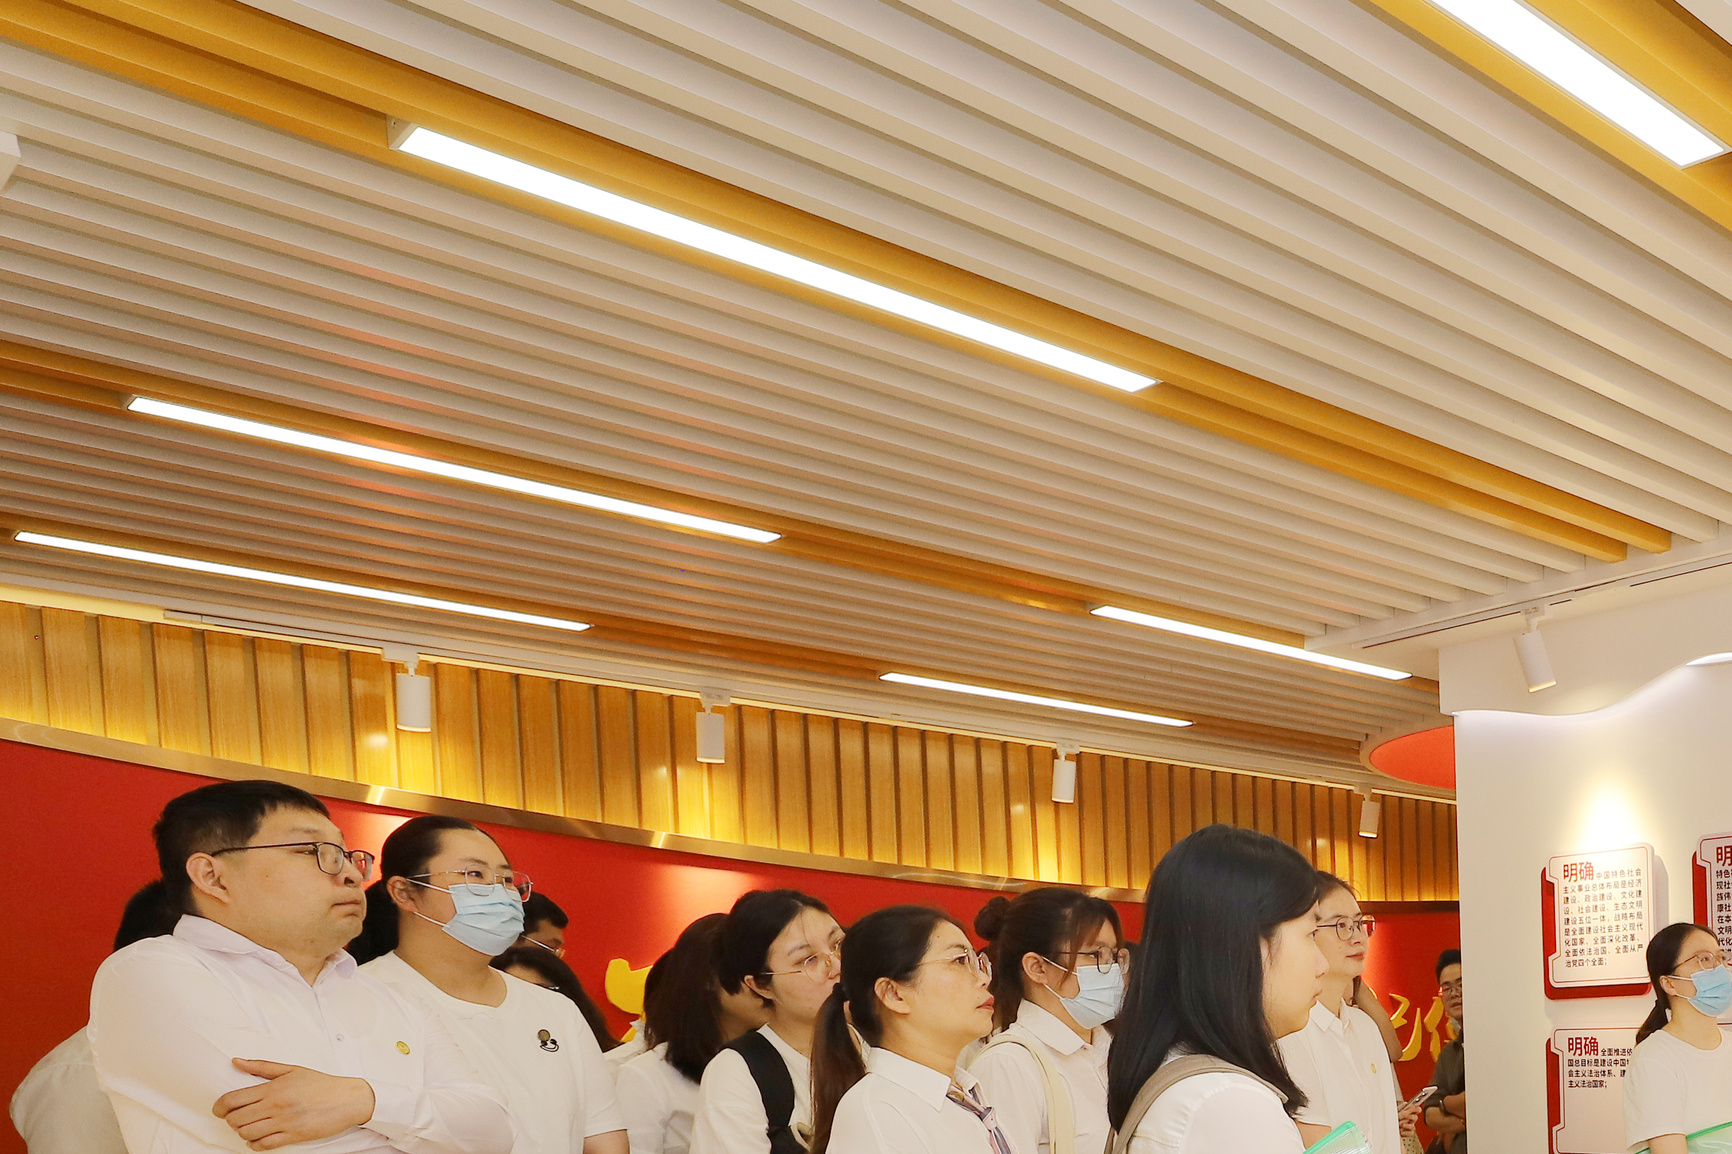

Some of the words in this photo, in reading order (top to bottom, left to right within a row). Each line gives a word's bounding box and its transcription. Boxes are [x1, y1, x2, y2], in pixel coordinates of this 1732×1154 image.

[1563, 862, 1594, 882] 明确
[1596, 868, 1641, 879] 中国特色社会
[1564, 879, 1642, 894] 主义事业总体布局是经济
[1565, 923, 1643, 936] 是全面建设社会主义现代
[1568, 1036, 1598, 1056] 明确
[1568, 1059, 1629, 1067] 国总目标是建设中国
